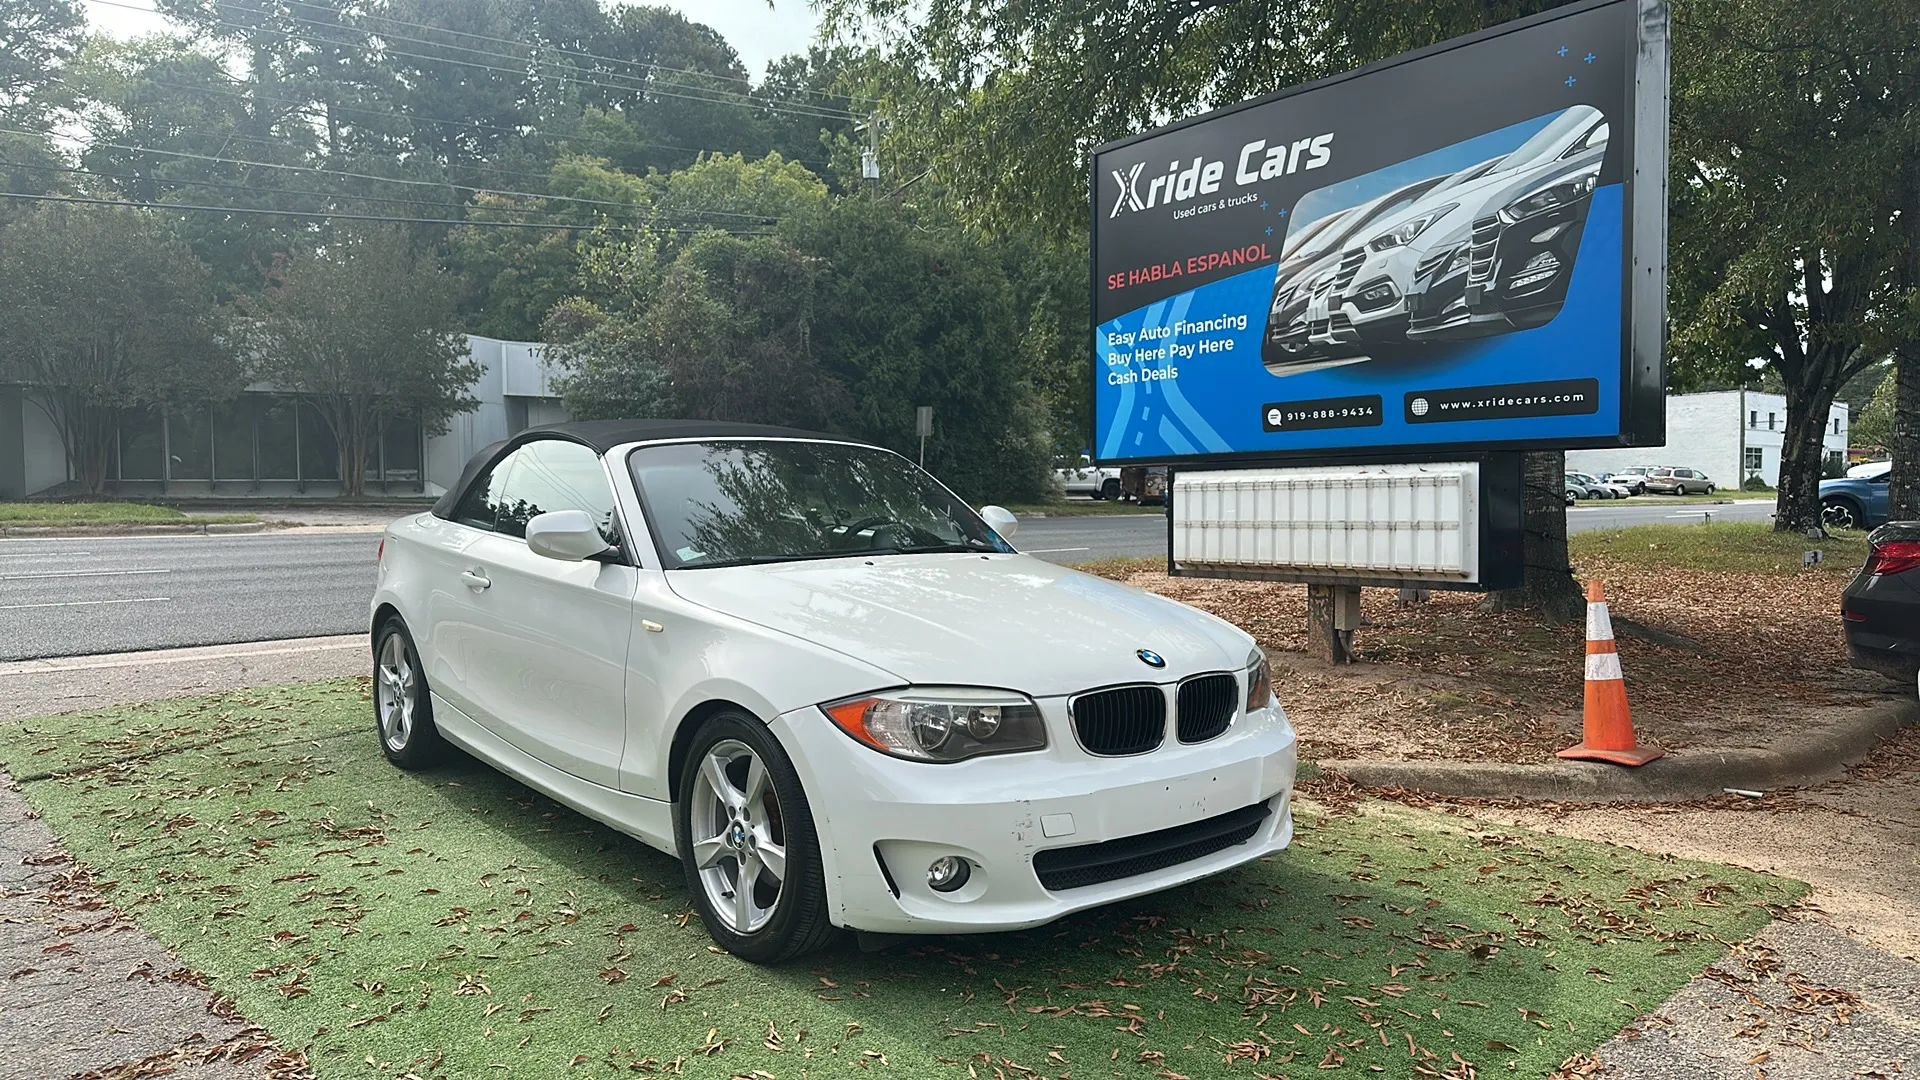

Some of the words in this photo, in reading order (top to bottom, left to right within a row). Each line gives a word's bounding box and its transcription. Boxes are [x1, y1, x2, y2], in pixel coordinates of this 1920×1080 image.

[1235, 132, 1335, 186] Cars
[1173, 203, 1196, 220] Used
[1197, 201, 1218, 215] cars
[1218, 199, 1226, 209] &
[1227, 192, 1258, 208] trucks
[1108, 271, 1125, 290] SE
[1129, 260, 1184, 286] HABLA
[1187, 243, 1272, 275] ESPANOL
[1108, 331, 1137, 347] Easy
[1138, 325, 1171, 342] Auto
[1174, 313, 1248, 336] Financing
[1108, 352, 1133, 368] Buy
[1135, 346, 1166, 363] Here
[1169, 343, 1194, 360] Pay
[1198, 338, 1234, 355] Here
[1108, 369, 1138, 386] Cash
[1141, 365, 1179, 382] Deals
[1286, 406, 1374, 422] 919-888-9434
[1439, 392, 1585, 410] www.xridecars.com
